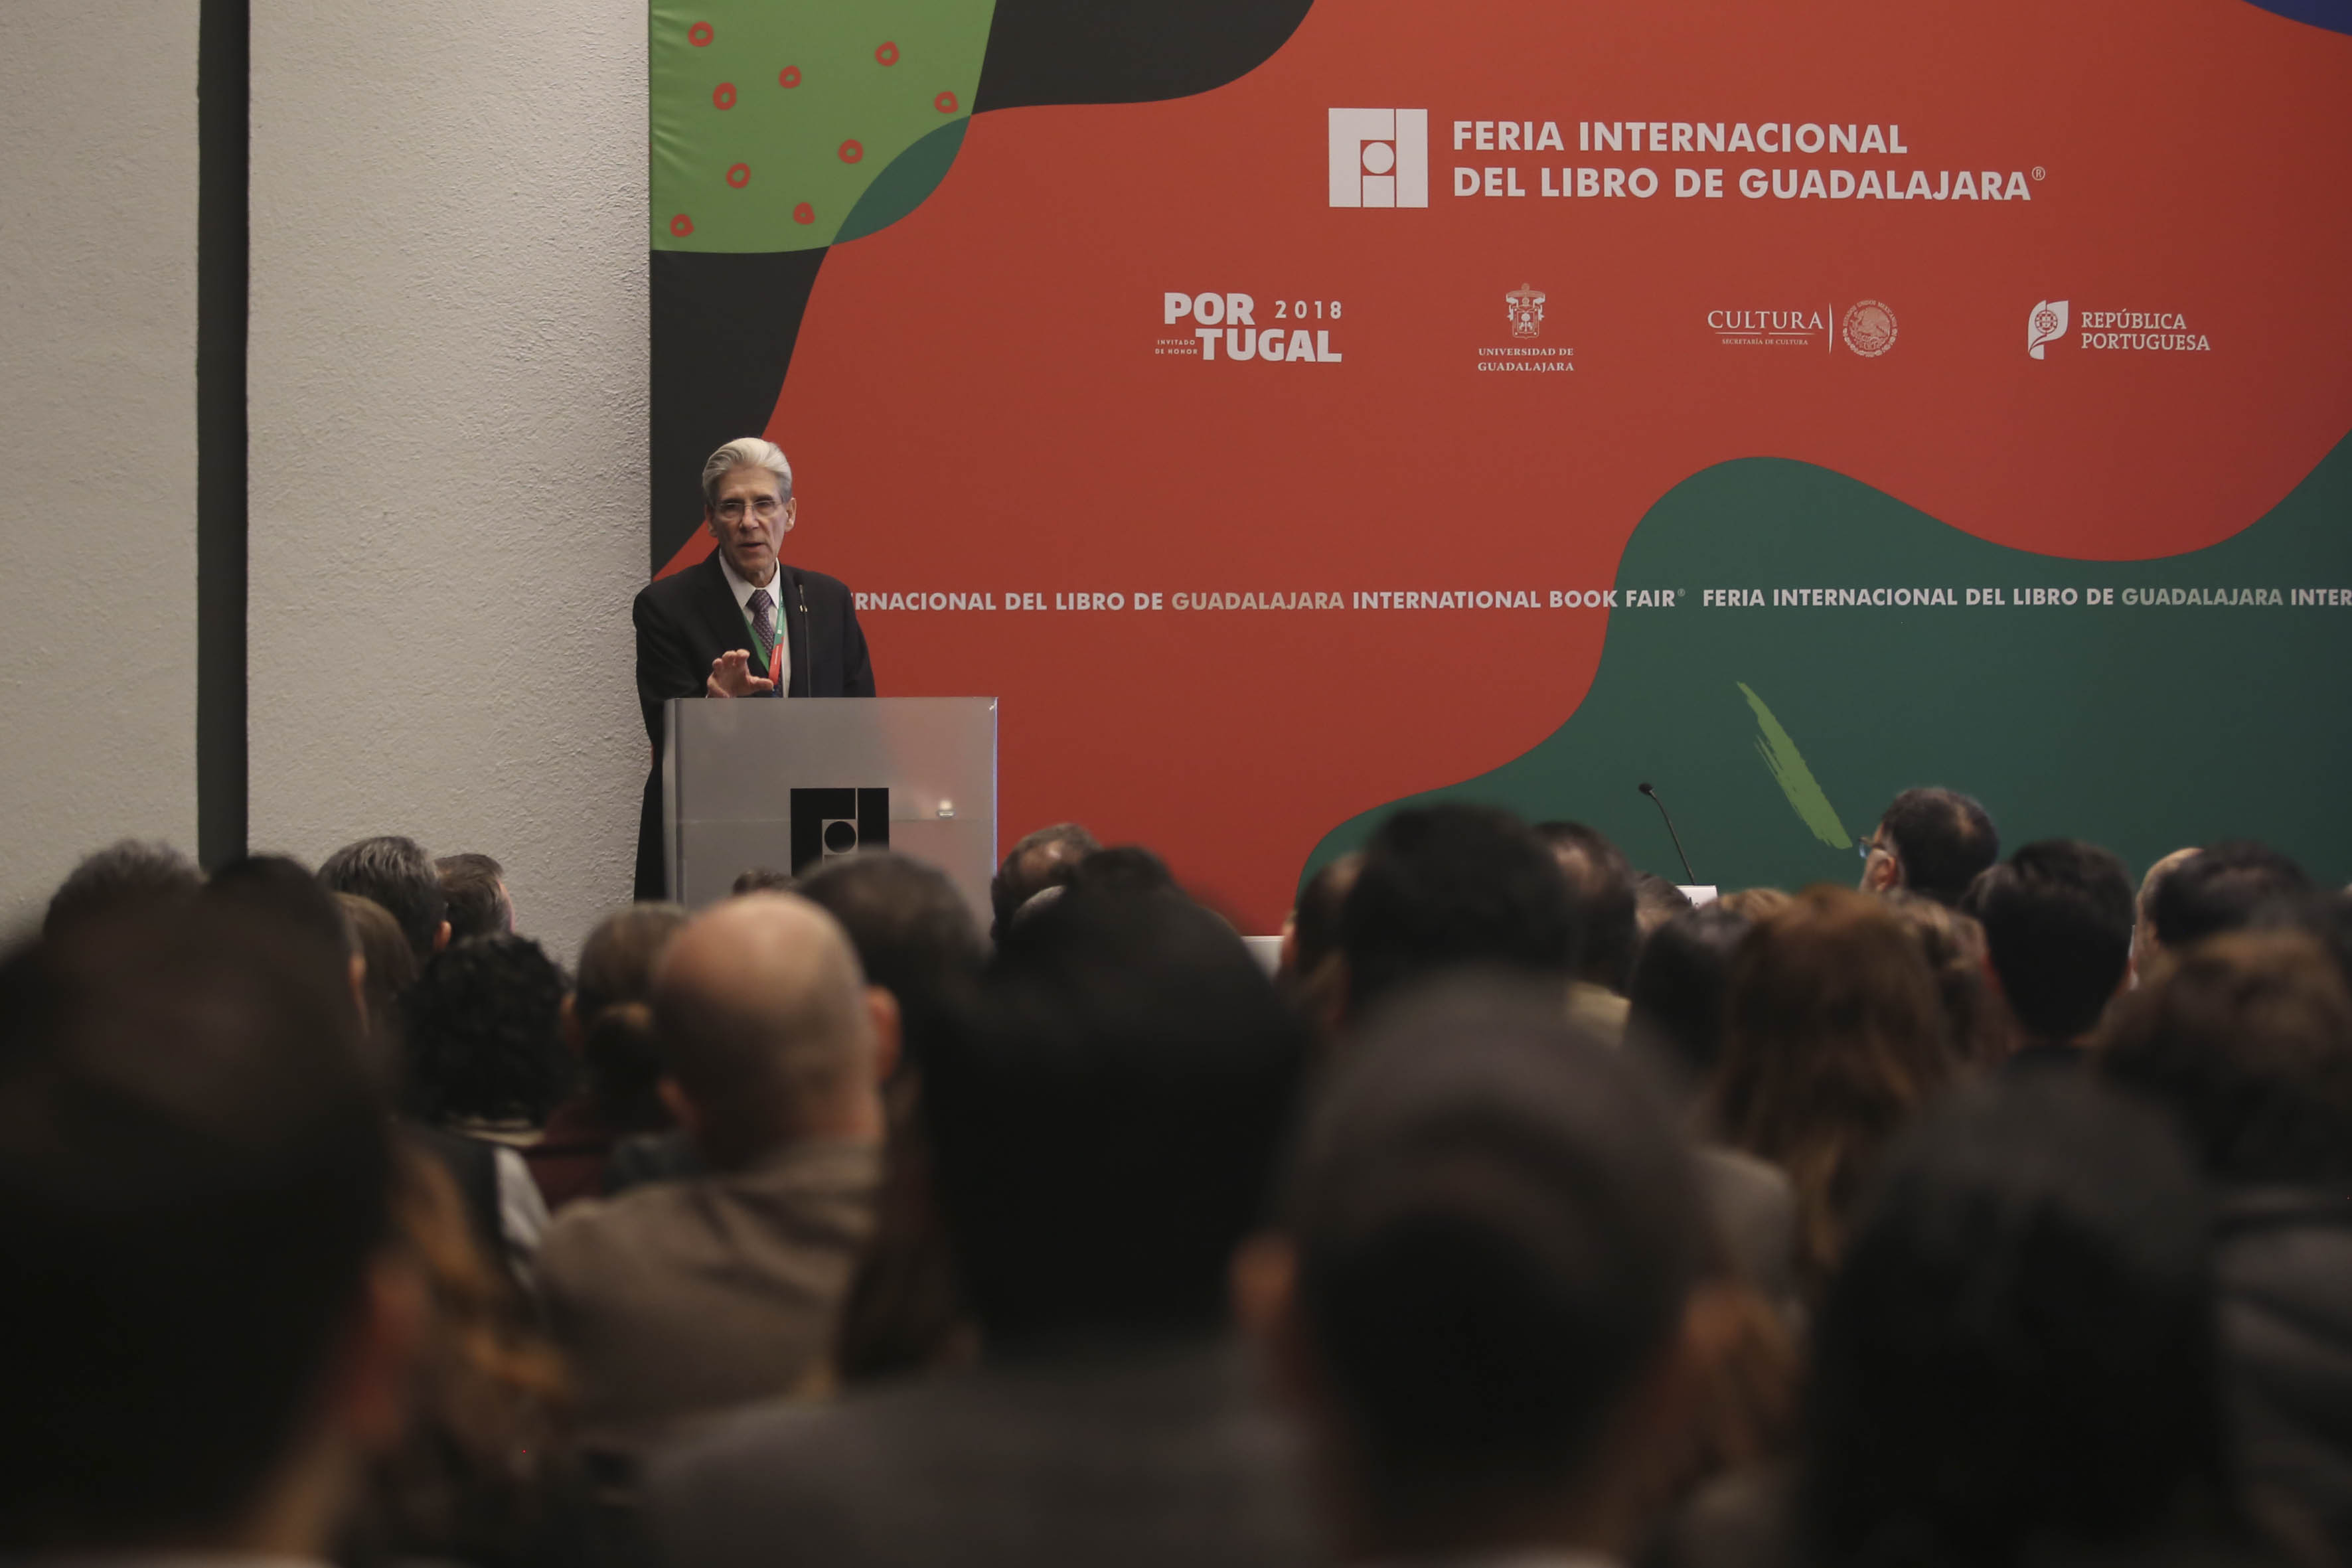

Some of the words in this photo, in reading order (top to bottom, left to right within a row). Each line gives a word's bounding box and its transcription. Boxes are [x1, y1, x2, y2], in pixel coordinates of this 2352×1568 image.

[1454, 121, 1565, 151] FERIA
[1579, 122, 1908, 155] INTERNACIONAL
[1454, 167, 1526, 197] DEL
[1541, 167, 1658, 198] LIBRO
[1675, 169, 1724, 198] DE
[1164, 292, 1255, 325] POR
[1275, 300, 1342, 319] 2018
[1707, 310, 1824, 329] CULTURA
[2081, 308, 2187, 329] REPÚBLICA
[1194, 328, 1343, 362] TUGAL
[2081, 333, 2211, 351] PORTUGUESA
[1478, 362, 1574, 372] GUADALAJARA
[850, 592, 996, 611] RNACIONAL
[1005, 592, 1048, 611] DEL
[1056, 592, 1125, 611] LIBRO
[1134, 592, 1163, 610] DE
[1172, 591, 1345, 611] GUADALAJARA
[1353, 591, 1541, 609] INTERNATIONAL
[1549, 589, 1618, 608] BOOK
[1703, 589, 1765, 607] FERIA
[1773, 589, 1958, 606] INTERNACIONAL
[1966, 588, 2005, 605] DEL
[2013, 588, 2078, 605] LIBRO
[2086, 588, 2114, 605] DE
[2121, 588, 2284, 606] GUADALAJARA
[2291, 589, 2352, 606] INTER
